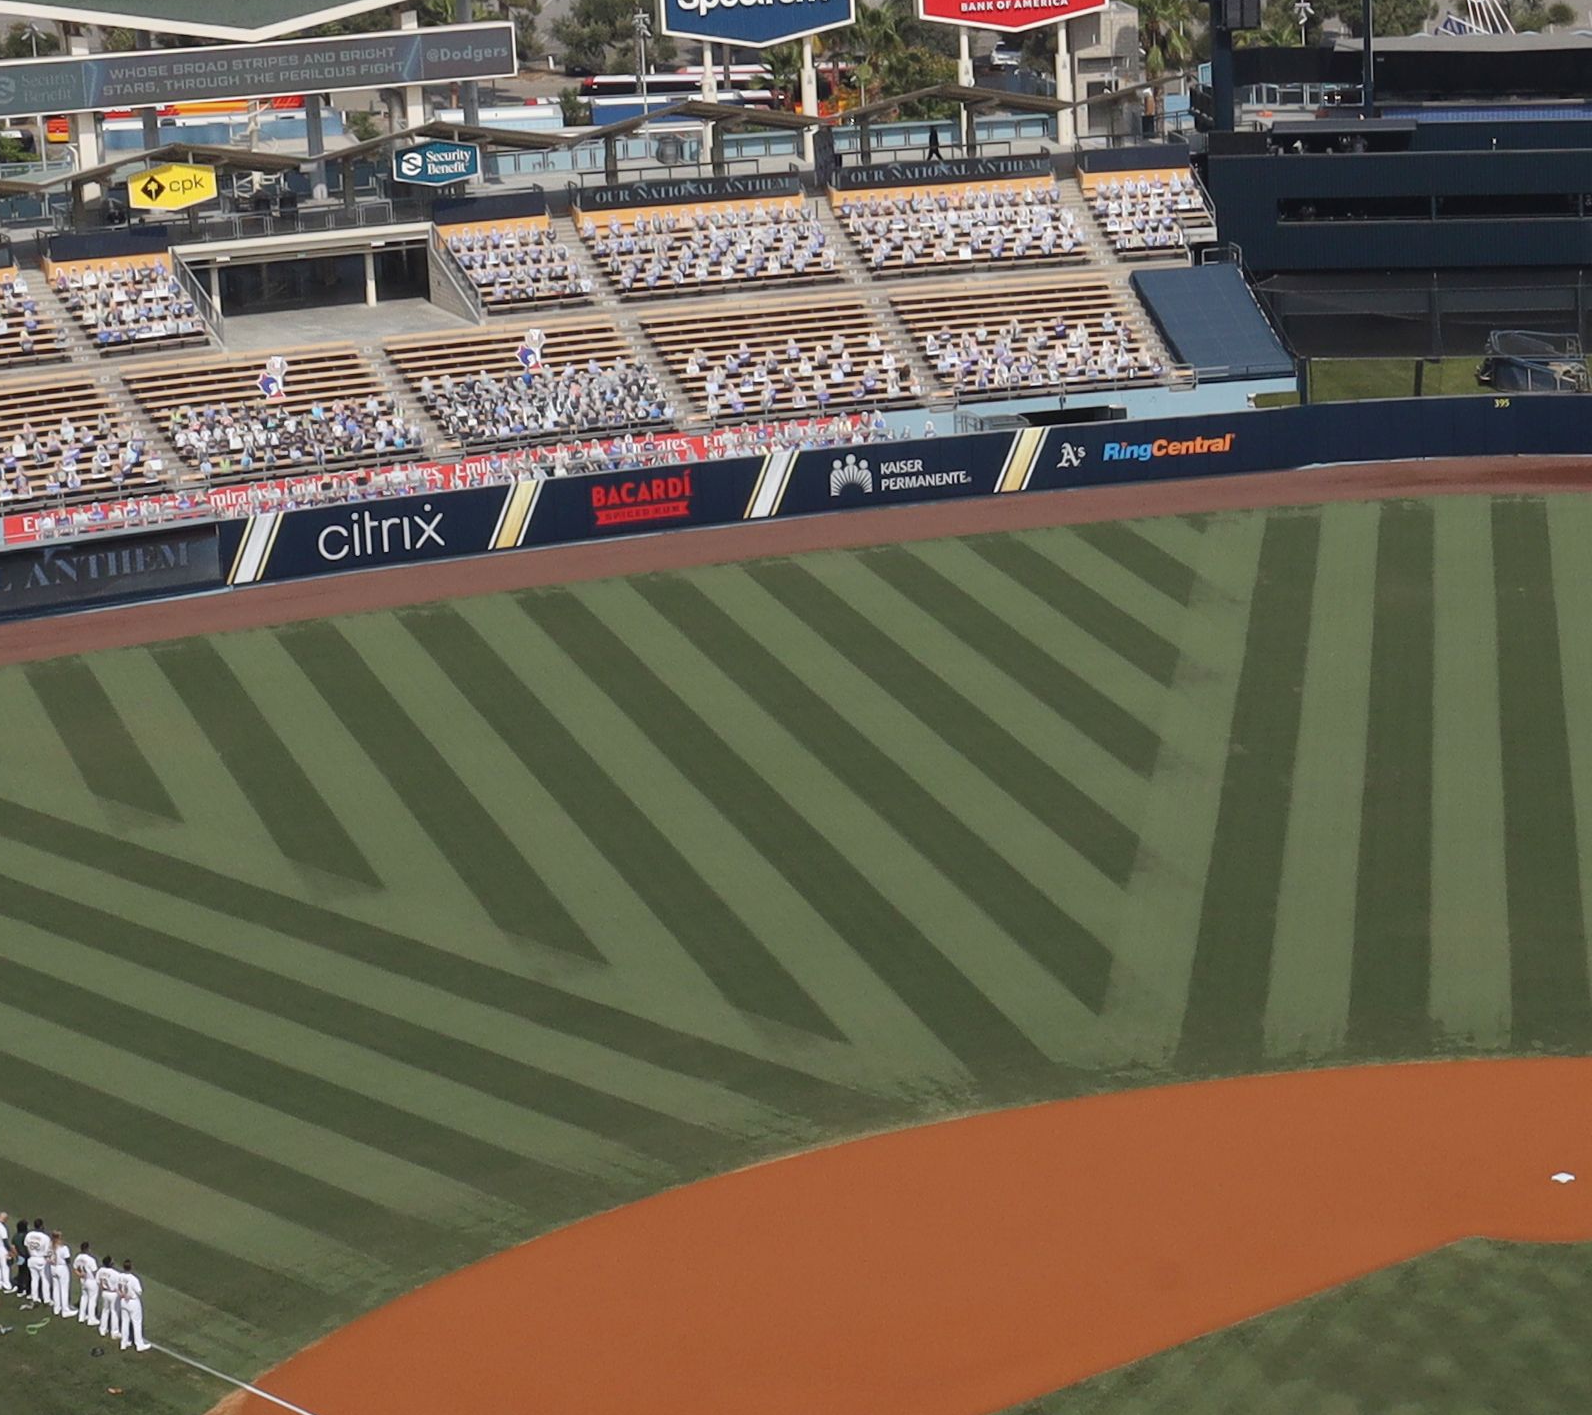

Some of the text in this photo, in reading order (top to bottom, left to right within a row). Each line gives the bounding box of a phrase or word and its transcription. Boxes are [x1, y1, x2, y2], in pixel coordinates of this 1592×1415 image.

[960, 0, 993, 12] BANK
[109, 46, 395, 79] WHOSE BROAD STRIPES AND BRIGHT
[426, 44, 508, 64] @Dodgers
[103, 61, 404, 97] STARS, THROUGH THE PERILOUS FIGHT
[425, 148, 471, 166] Security
[427, 161, 468, 178] Benefit
[851, 158, 1042, 183] OUR NATIONAL ANTHEM
[168, 174, 205, 194] cpk
[595, 177, 790, 203] OUR NATIONAL ANTHEM
[1494, 398, 1510, 409] 395
[1103, 433, 1231, 461] RingCentral
[880, 459, 923, 475] KAISER
[881, 471, 967, 491] PERMANENTE
[319, 503, 444, 562] citrix
[25, 542, 190, 591] ANTHEM
